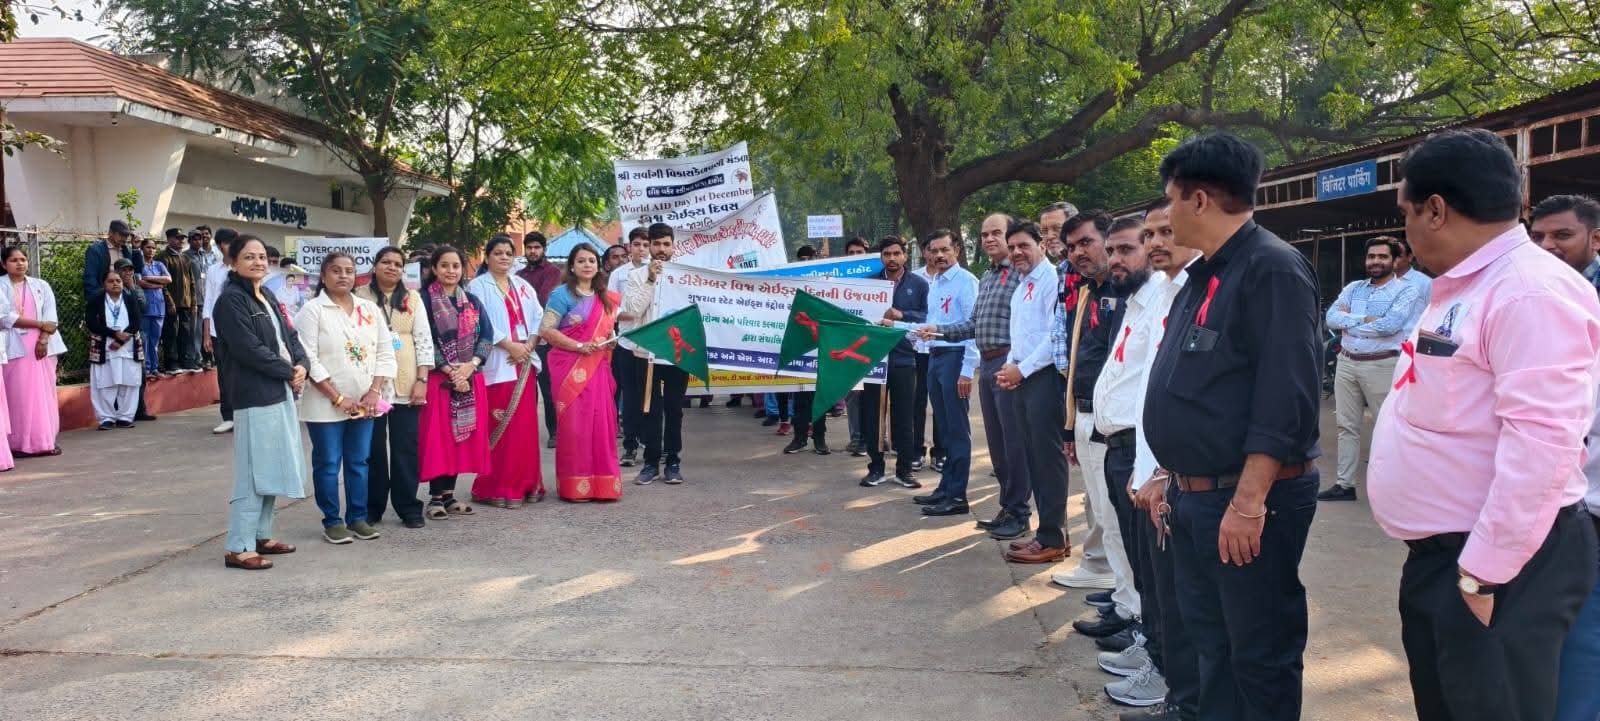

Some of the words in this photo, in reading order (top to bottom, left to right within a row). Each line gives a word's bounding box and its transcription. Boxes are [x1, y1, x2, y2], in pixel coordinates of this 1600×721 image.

[617, 171, 630, 181] શ્રી
[1321, 175, 1346, 193] विजिटर
[1347, 167, 1371, 189] पार्किंग
[620, 202, 650, 214] World
[653, 202, 672, 212] AID
[674, 198, 691, 210] Day
[695, 193, 706, 203] 1st
[709, 188, 753, 200] December
[708, 202, 739, 213] દિવસ
[302, 245, 370, 254] OVERCOMING
[731, 279, 755, 293] વિશ્વ
[843, 288, 888, 303] ઉજવણી
[687, 294, 716, 304] ગુજરાત
[718, 295, 733, 304] સ્ટેટ
[722, 314, 735, 325] અને
[737, 317, 761, 328] પરિવાર
[758, 333, 783, 344] સંચાલિ
[721, 351, 735, 361] અને
